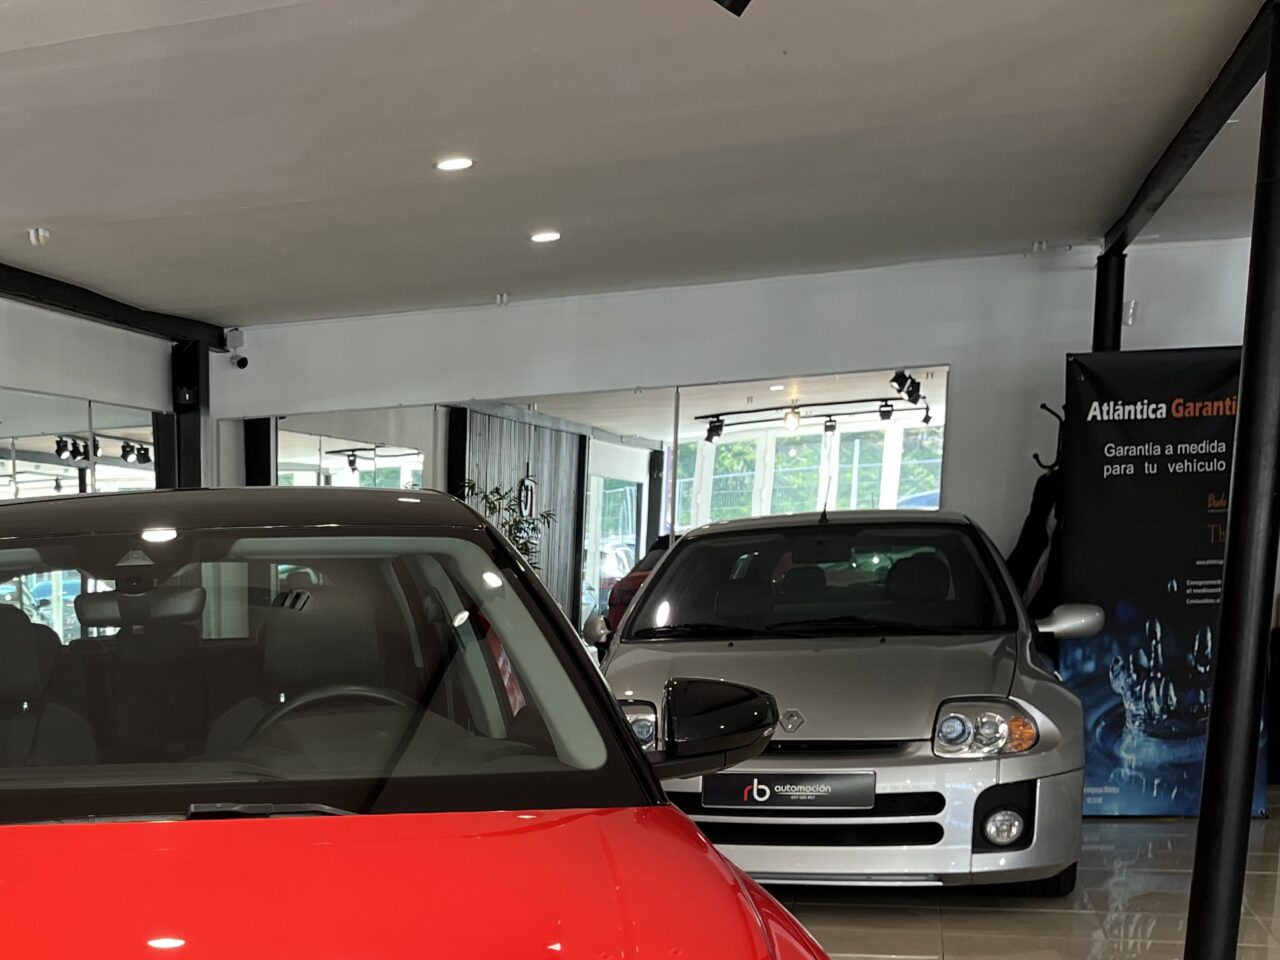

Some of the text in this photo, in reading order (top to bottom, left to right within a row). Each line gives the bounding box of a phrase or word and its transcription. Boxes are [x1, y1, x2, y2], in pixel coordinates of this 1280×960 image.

[1086, 399, 1167, 421] Atlántica
[1165, 444, 1173, 455] a
[1177, 440, 1226, 455] medida
[1103, 463, 1134, 479] para
[1144, 461, 1157, 474] tu
[774, 783, 832, 793] automoción
